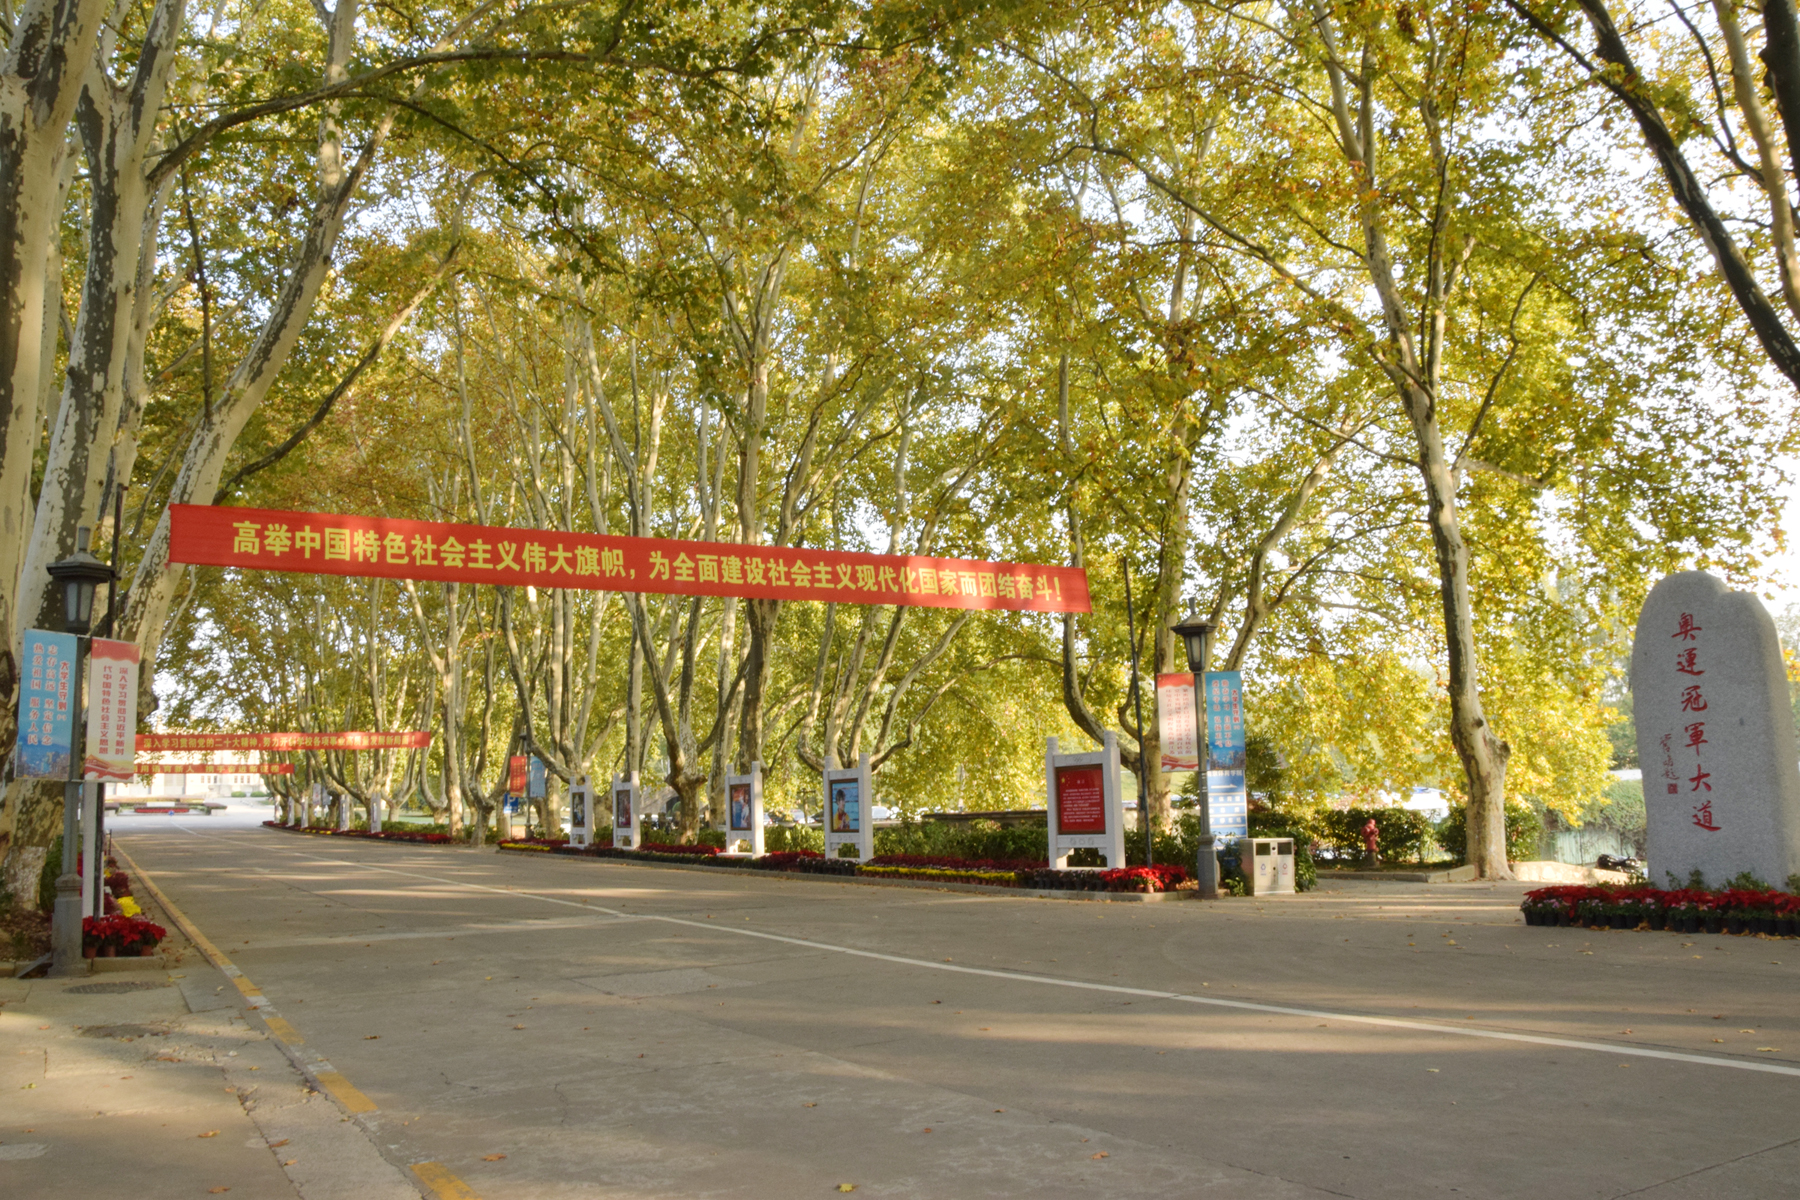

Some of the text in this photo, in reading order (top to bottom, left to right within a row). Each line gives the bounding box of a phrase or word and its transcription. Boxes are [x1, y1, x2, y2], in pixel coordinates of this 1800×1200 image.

[28, 643, 44, 746] 热爱祖国 服务人民
[41, 644, 58, 746] 志存高远 坚定信念
[99, 665, 113, 755] 代中国特色社会主义思想
[115, 667, 128, 756] 深入学习贯彻习近平新时
